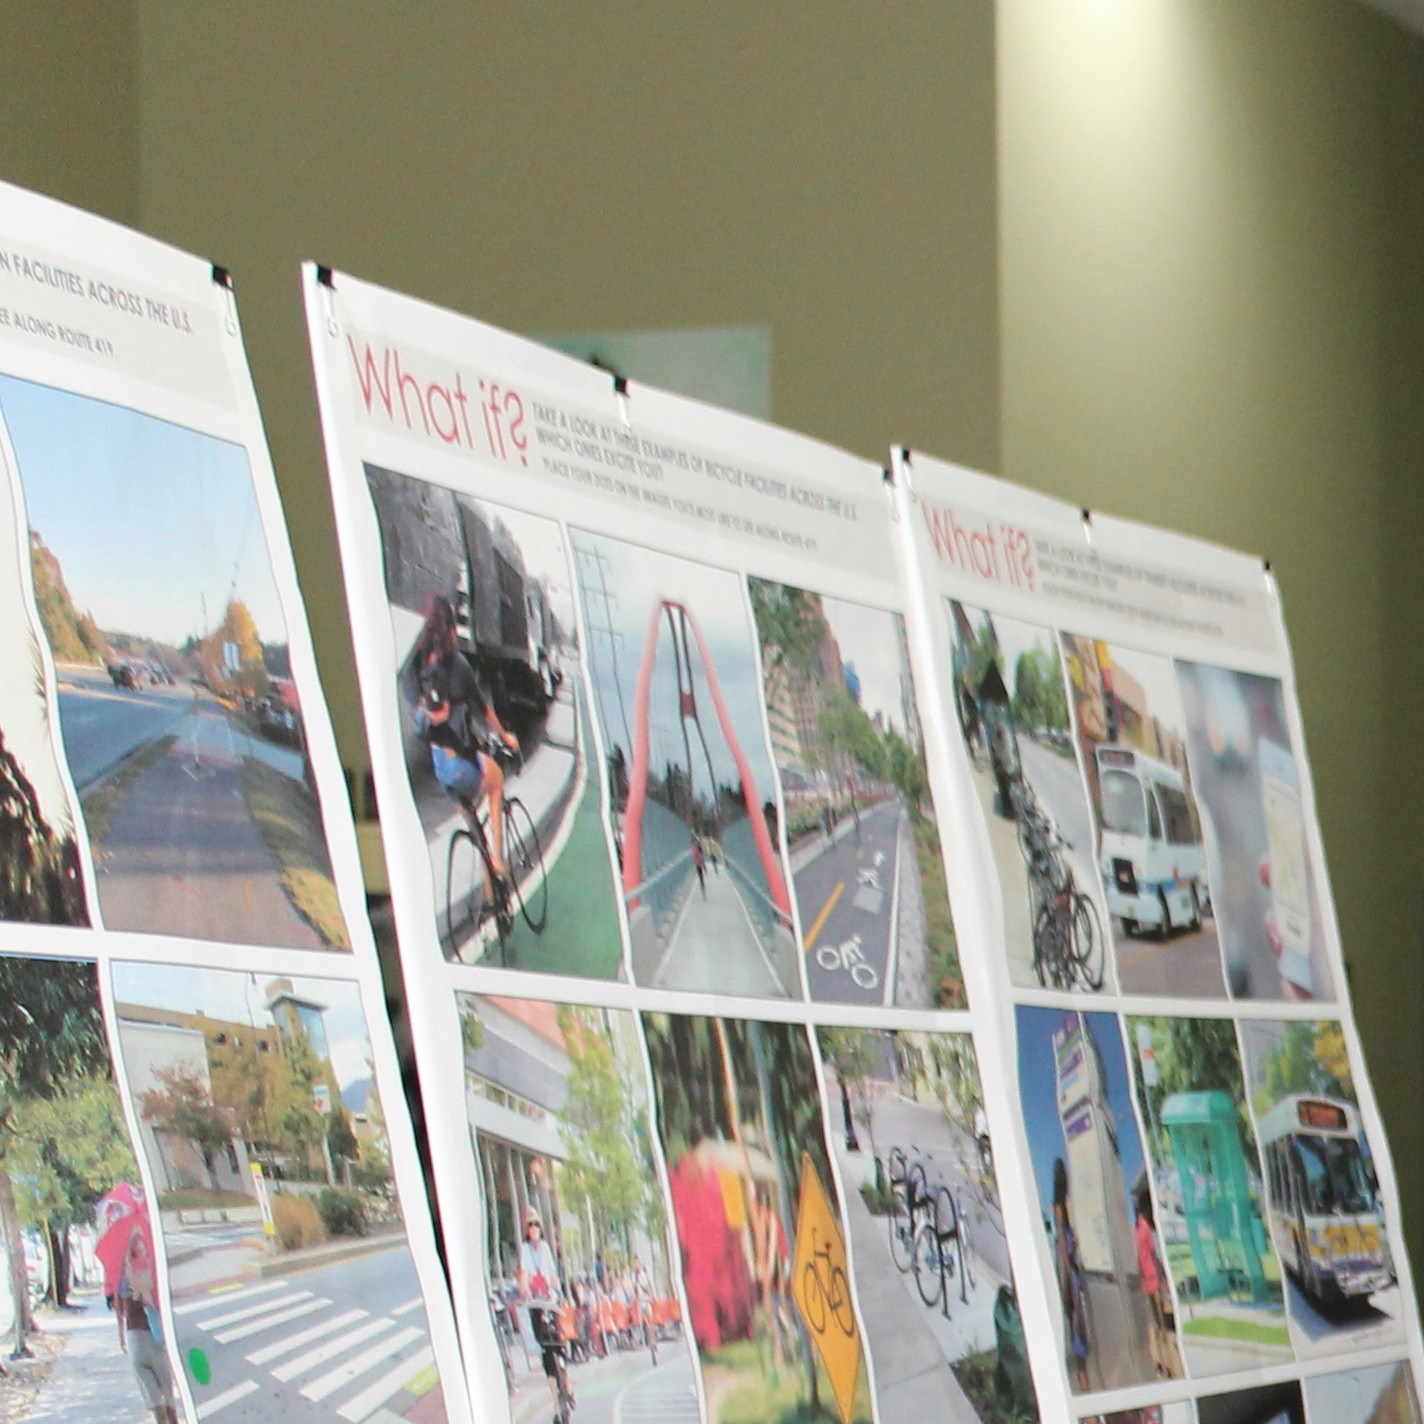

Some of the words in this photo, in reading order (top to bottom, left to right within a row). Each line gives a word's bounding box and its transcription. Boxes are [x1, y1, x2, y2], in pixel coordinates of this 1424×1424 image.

[12, 253, 84, 297] FACILITIES
[87, 279, 144, 317] ACROSS
[144, 298, 169, 326] THE
[13, 311, 56, 340] ALONG
[56, 322, 94, 352] ROUTE
[347, 334, 473, 450] What
[479, 377, 528, 468] if?
[921, 501, 1000, 583] What
